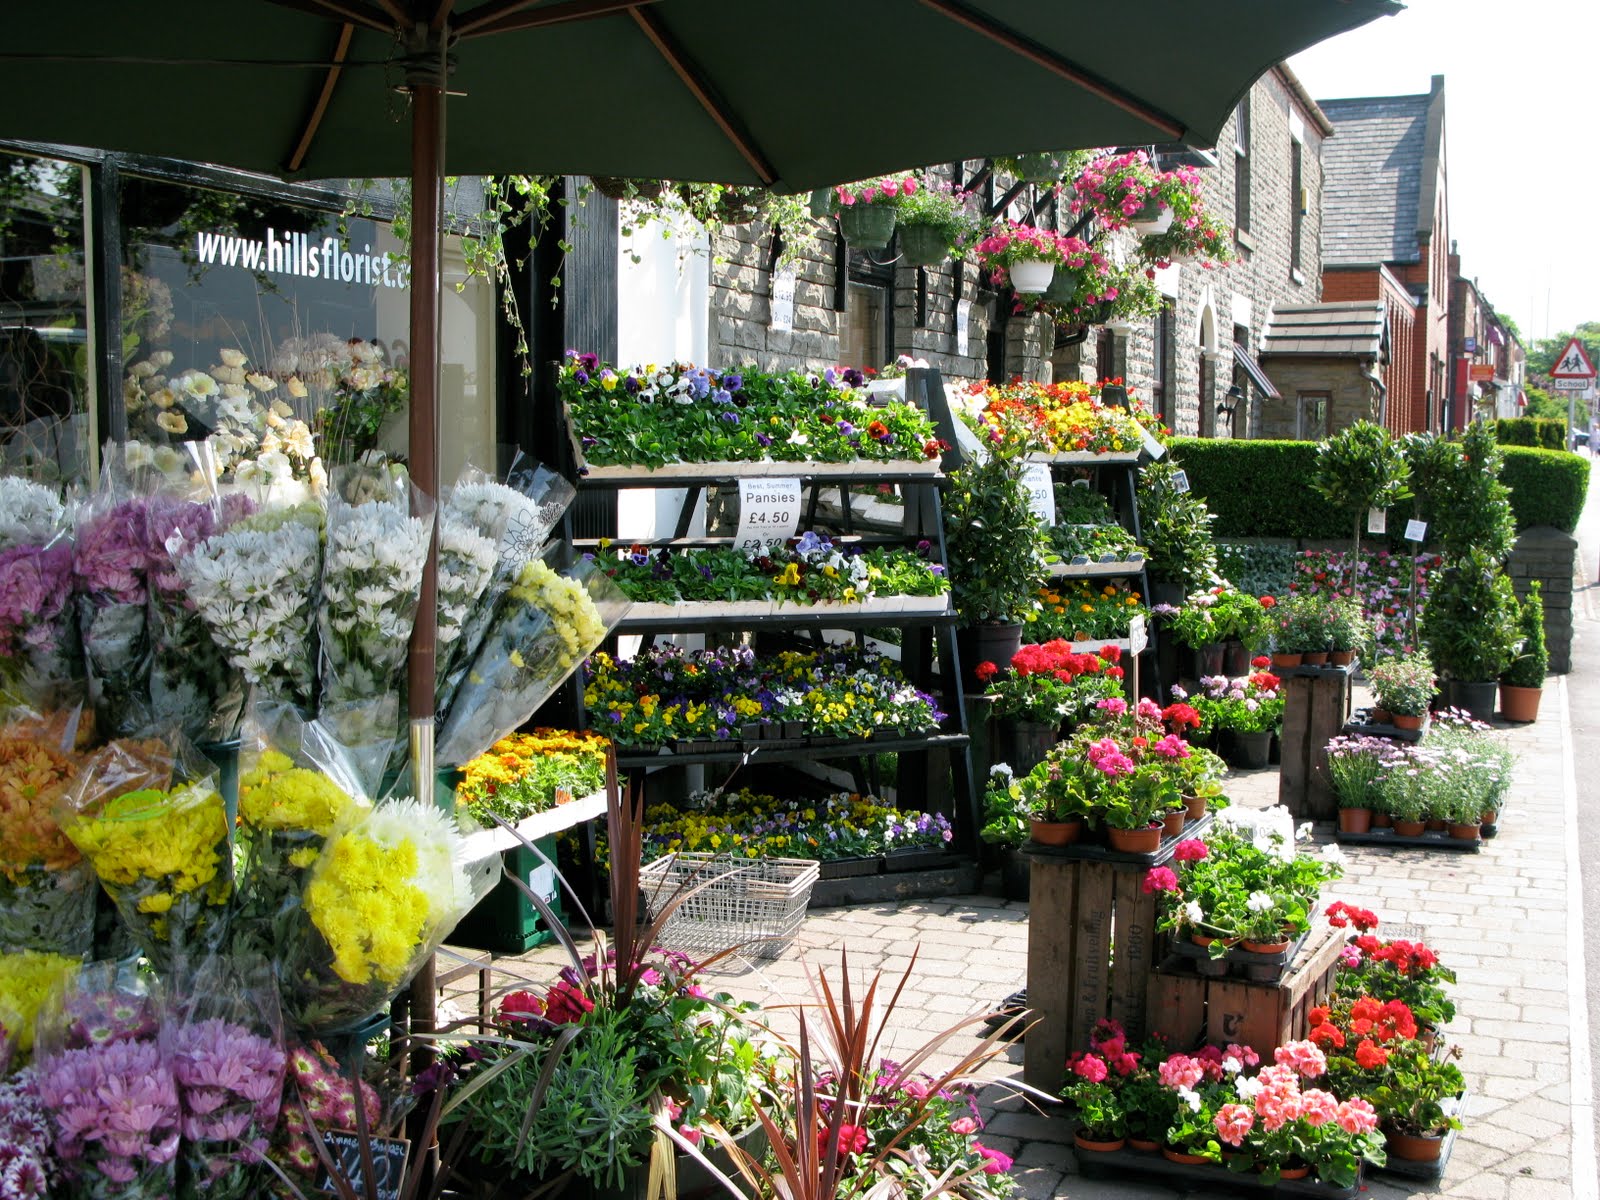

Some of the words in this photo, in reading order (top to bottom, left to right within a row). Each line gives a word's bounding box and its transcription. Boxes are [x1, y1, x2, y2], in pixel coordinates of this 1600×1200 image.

[1557, 379, 1586, 388] School
[746, 492, 796, 503] Pansies
[749, 511, 790, 523] £4.50
